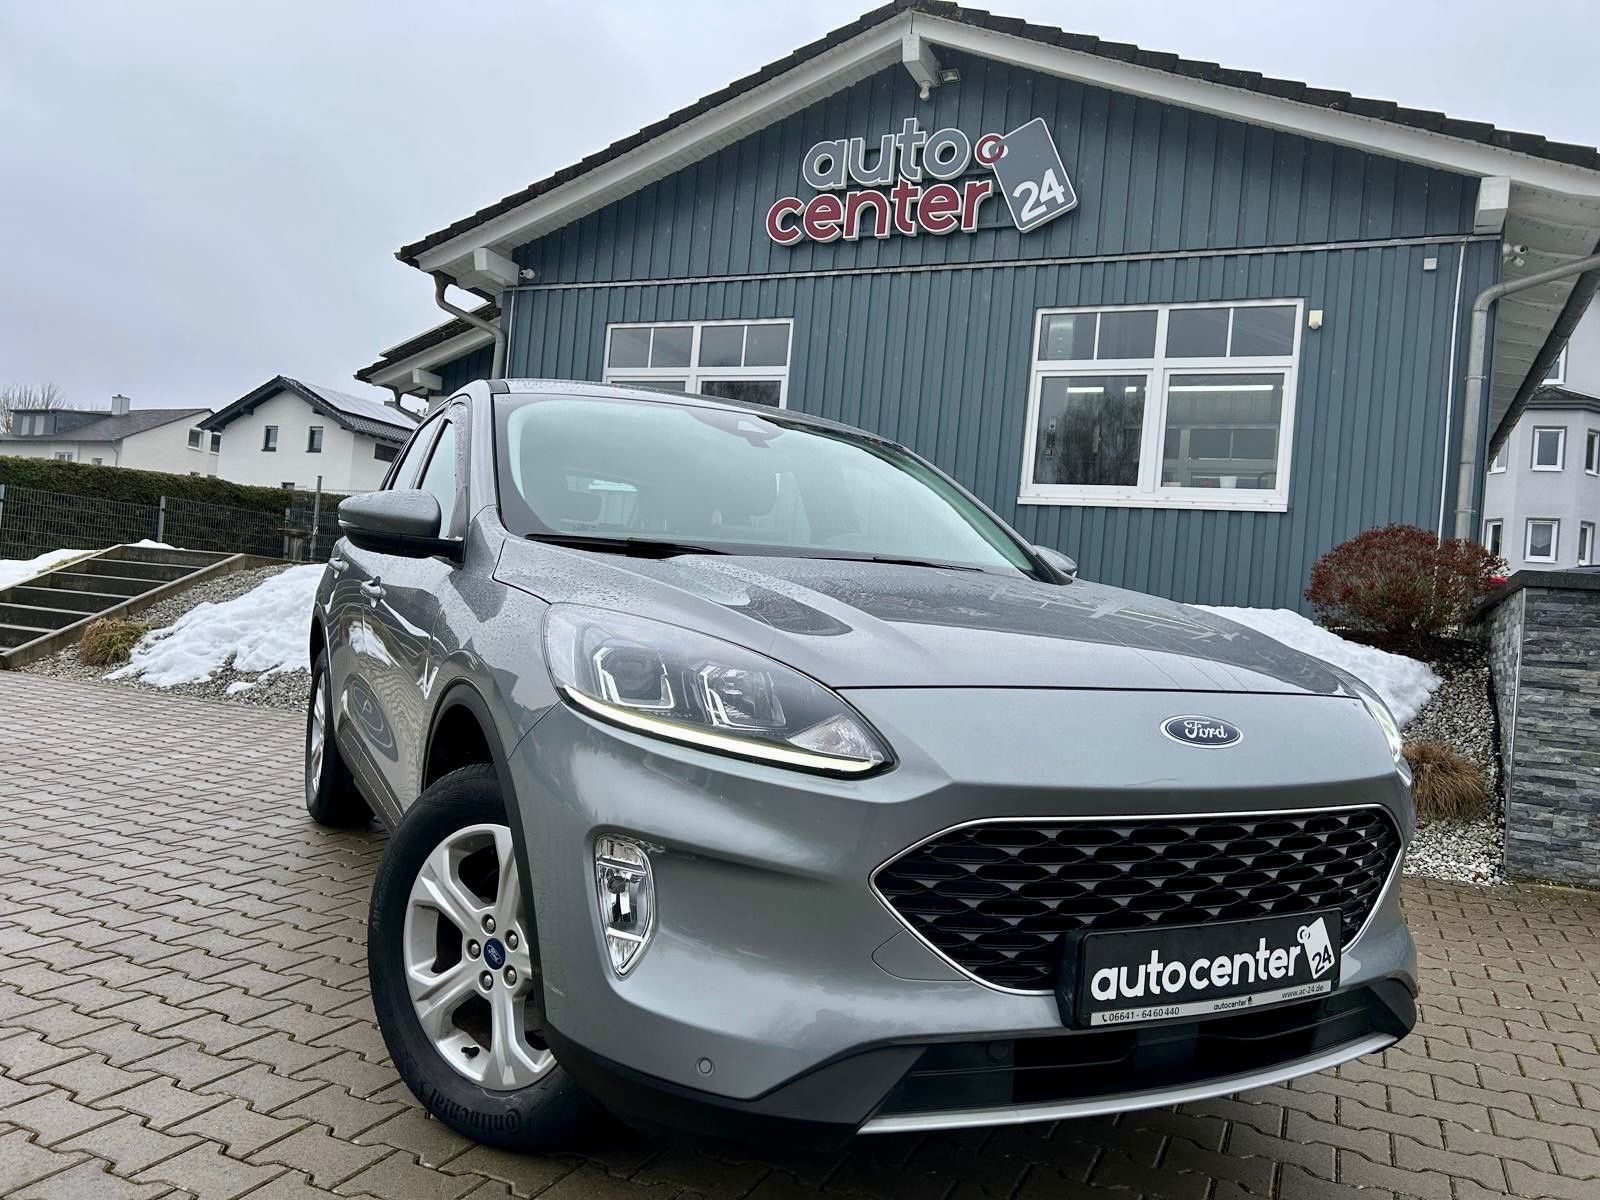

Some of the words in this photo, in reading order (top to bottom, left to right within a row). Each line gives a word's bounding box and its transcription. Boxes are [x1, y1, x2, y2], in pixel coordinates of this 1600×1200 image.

[803, 118, 971, 190] auto
[766, 174, 993, 246] center
[1012, 168, 1065, 223] 24
[1184, 720, 1228, 738] Ford
[1091, 938, 1301, 1001] autocenter
[1311, 944, 1334, 971] 24
[1213, 1000, 1246, 1011] autocenter
[1281, 984, 1324, 999] www.ac-24.de
[1109, 1011, 1134, 1022] 06641
[427, 1088, 522, 1135] Continental
